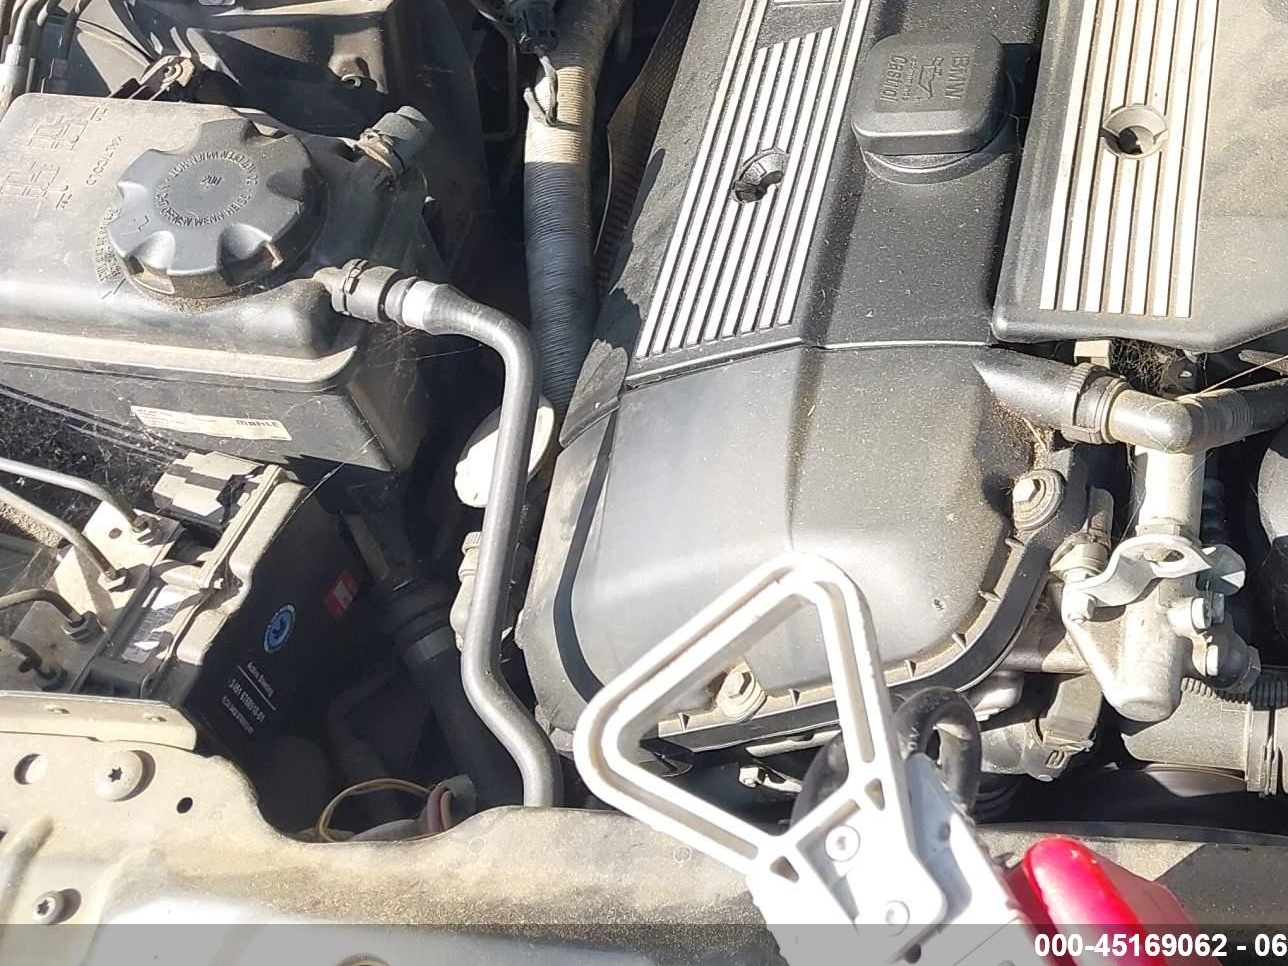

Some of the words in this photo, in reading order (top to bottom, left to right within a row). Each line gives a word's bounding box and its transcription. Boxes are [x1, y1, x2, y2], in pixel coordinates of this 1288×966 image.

[944, 55, 971, 99] BMW
[194, 213, 225, 226] WENN
[225, 194, 251, 215] HEISS
